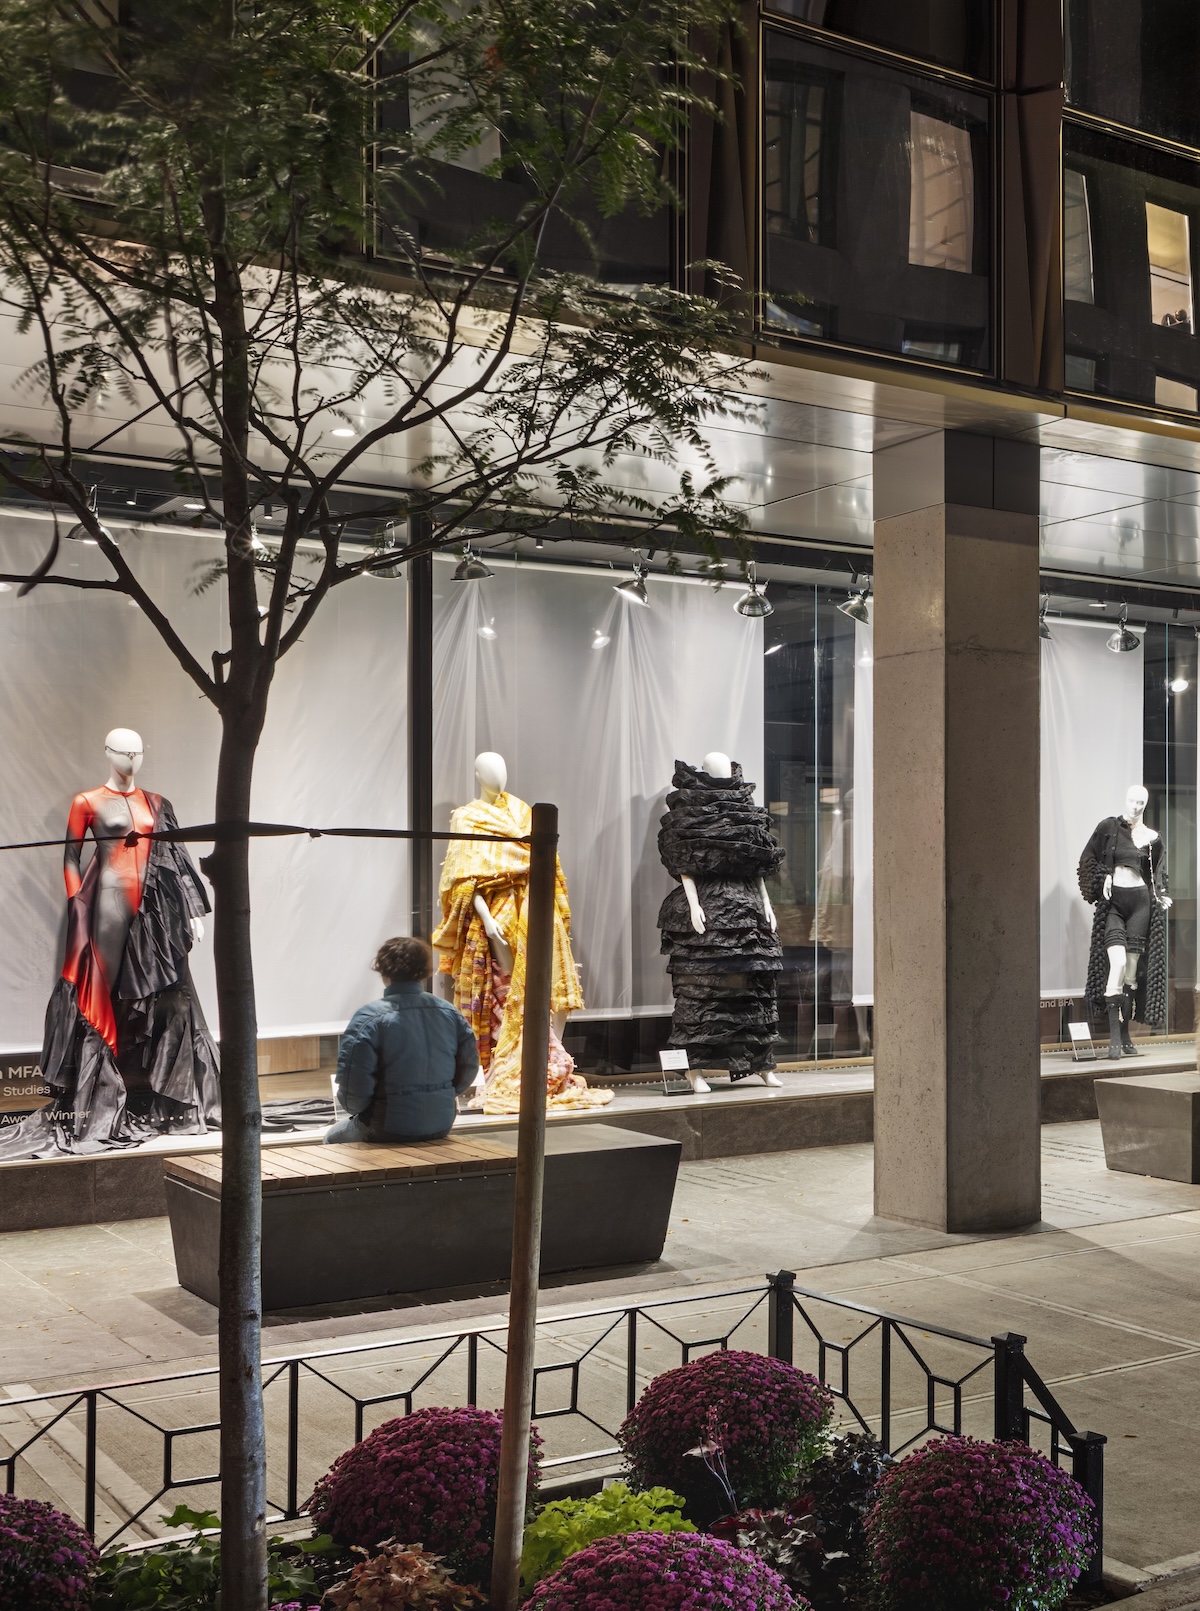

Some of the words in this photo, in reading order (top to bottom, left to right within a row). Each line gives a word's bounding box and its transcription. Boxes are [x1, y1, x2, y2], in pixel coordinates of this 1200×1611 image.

[1040, 999, 1055, 1008] and
[1058, 998, 1074, 1007] BFA
[8, 1065, 44, 1078] MFA
[3, 1085, 51, 1096] Studies
[1, 1112, 42, 1124] Award
[45, 1110, 91, 1121] Winner
